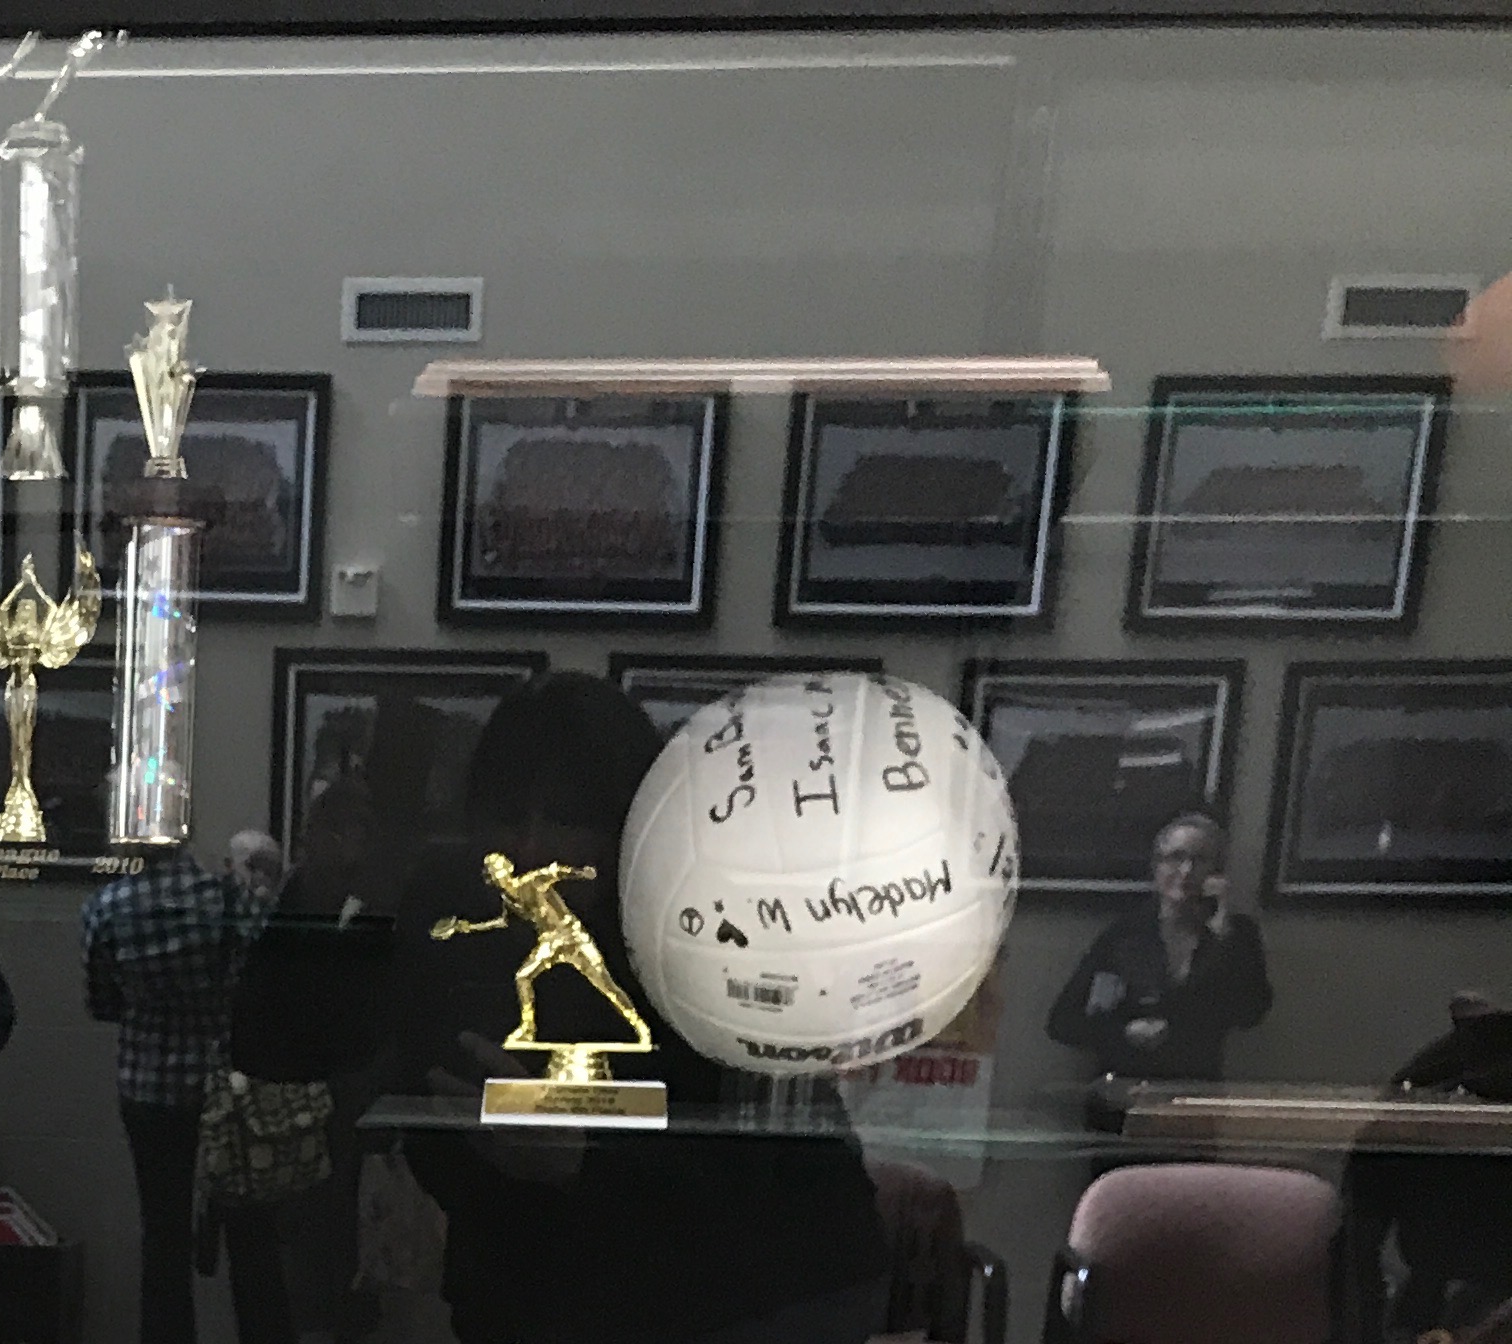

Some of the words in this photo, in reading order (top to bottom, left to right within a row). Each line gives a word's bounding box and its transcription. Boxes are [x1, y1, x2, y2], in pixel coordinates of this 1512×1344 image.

[710, 744, 757, 825] Sam
[793, 703, 840, 819] Isaac
[91, 856, 145, 875] 2010
[804, 860, 953, 924] Madelyn
